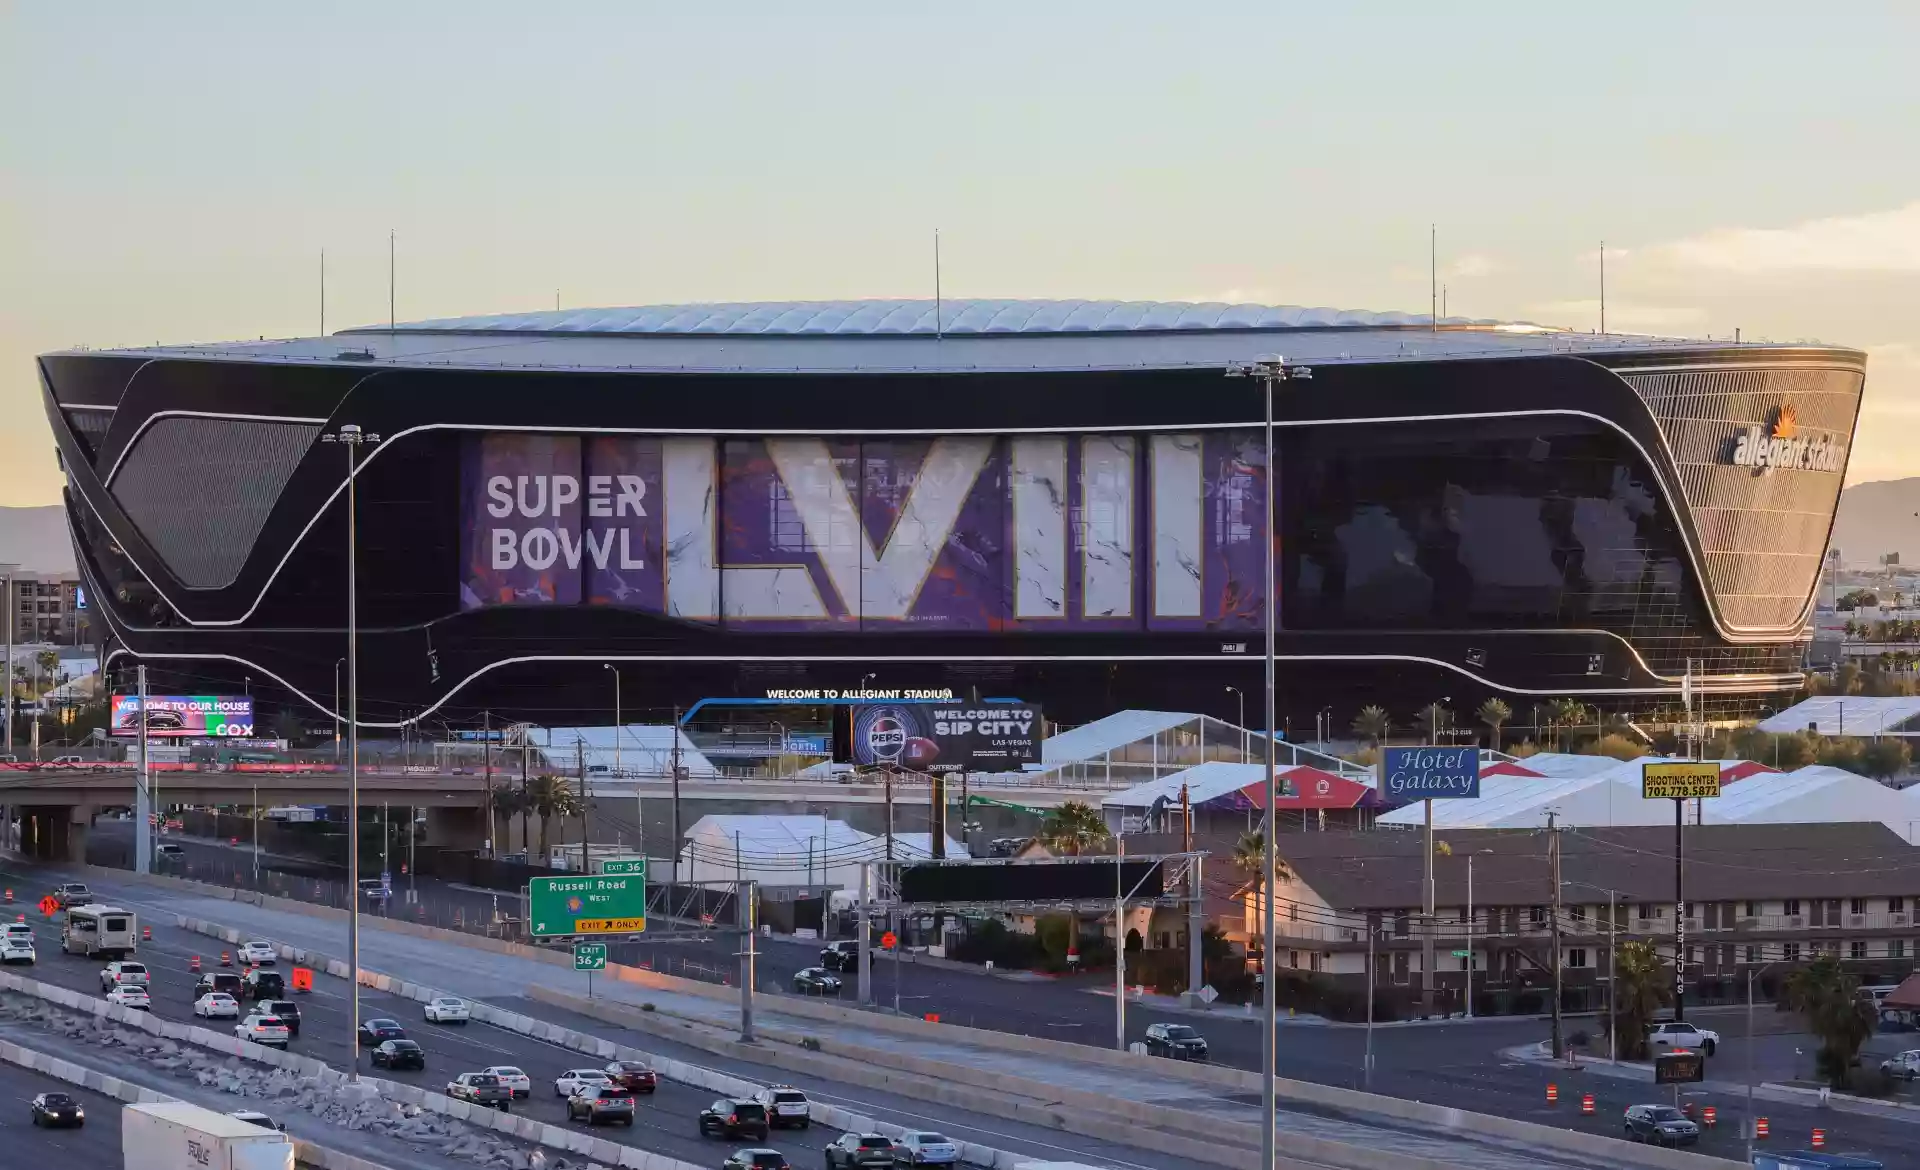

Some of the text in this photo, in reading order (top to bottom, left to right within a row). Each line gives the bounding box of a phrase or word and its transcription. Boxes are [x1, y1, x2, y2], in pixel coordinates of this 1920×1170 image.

[487, 475, 648, 518] SUPER
[661, 435, 1204, 620] LVIII
[492, 527, 645, 570] BOWL
[766, 689, 953, 699] WELCOME TO ALLEGIANT STADIUM
[116, 702, 250, 711] WELOME TO OUR HOUSE
[933, 710, 1033, 720] WELCOME TO
[215, 723, 254, 736] COX
[935, 721, 1033, 735] SIP CITY
[872, 733, 903, 742] PEPSI
[1397, 749, 1465, 770] Hotel
[1390, 769, 1473, 795] Galaxy
[1646, 775, 1716, 786] SHOOTING CENTER
[1648, 786, 1718, 796] 702.778.5872
[627, 863, 641, 871] 36
[549, 880, 626, 891] Russell Road
[581, 920, 640, 930] EXIT ONLY
[577, 956, 592, 965] 36
